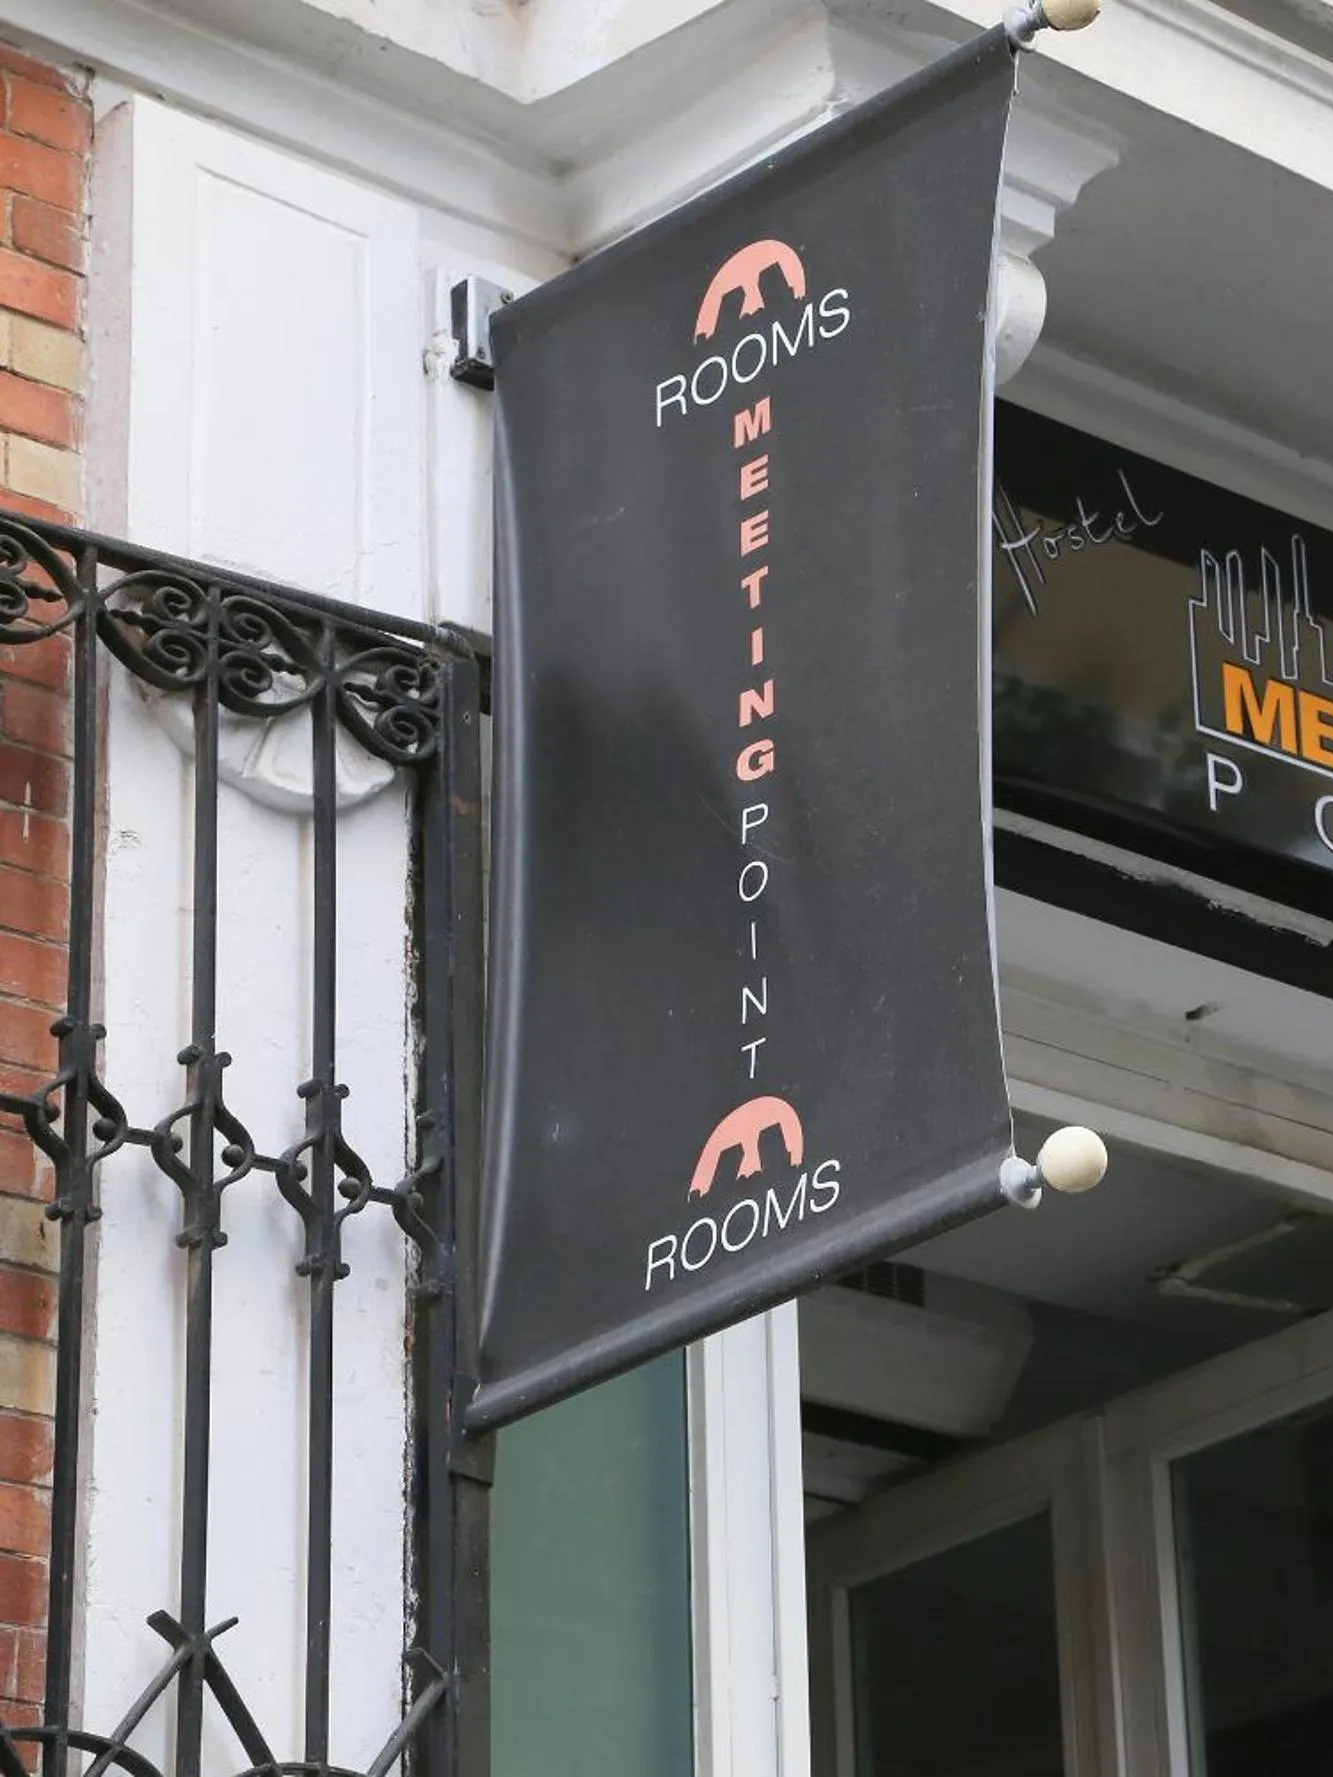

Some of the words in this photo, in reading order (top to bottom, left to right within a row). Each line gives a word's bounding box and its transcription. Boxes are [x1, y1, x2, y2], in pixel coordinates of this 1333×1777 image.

[655, 288, 851, 427] ROOMS
[733, 397, 775, 782] MEETING
[993, 469, 1164, 616] Hostel
[738, 803, 768, 1079] POINT
[644, 1159, 841, 1291] ROOMS
